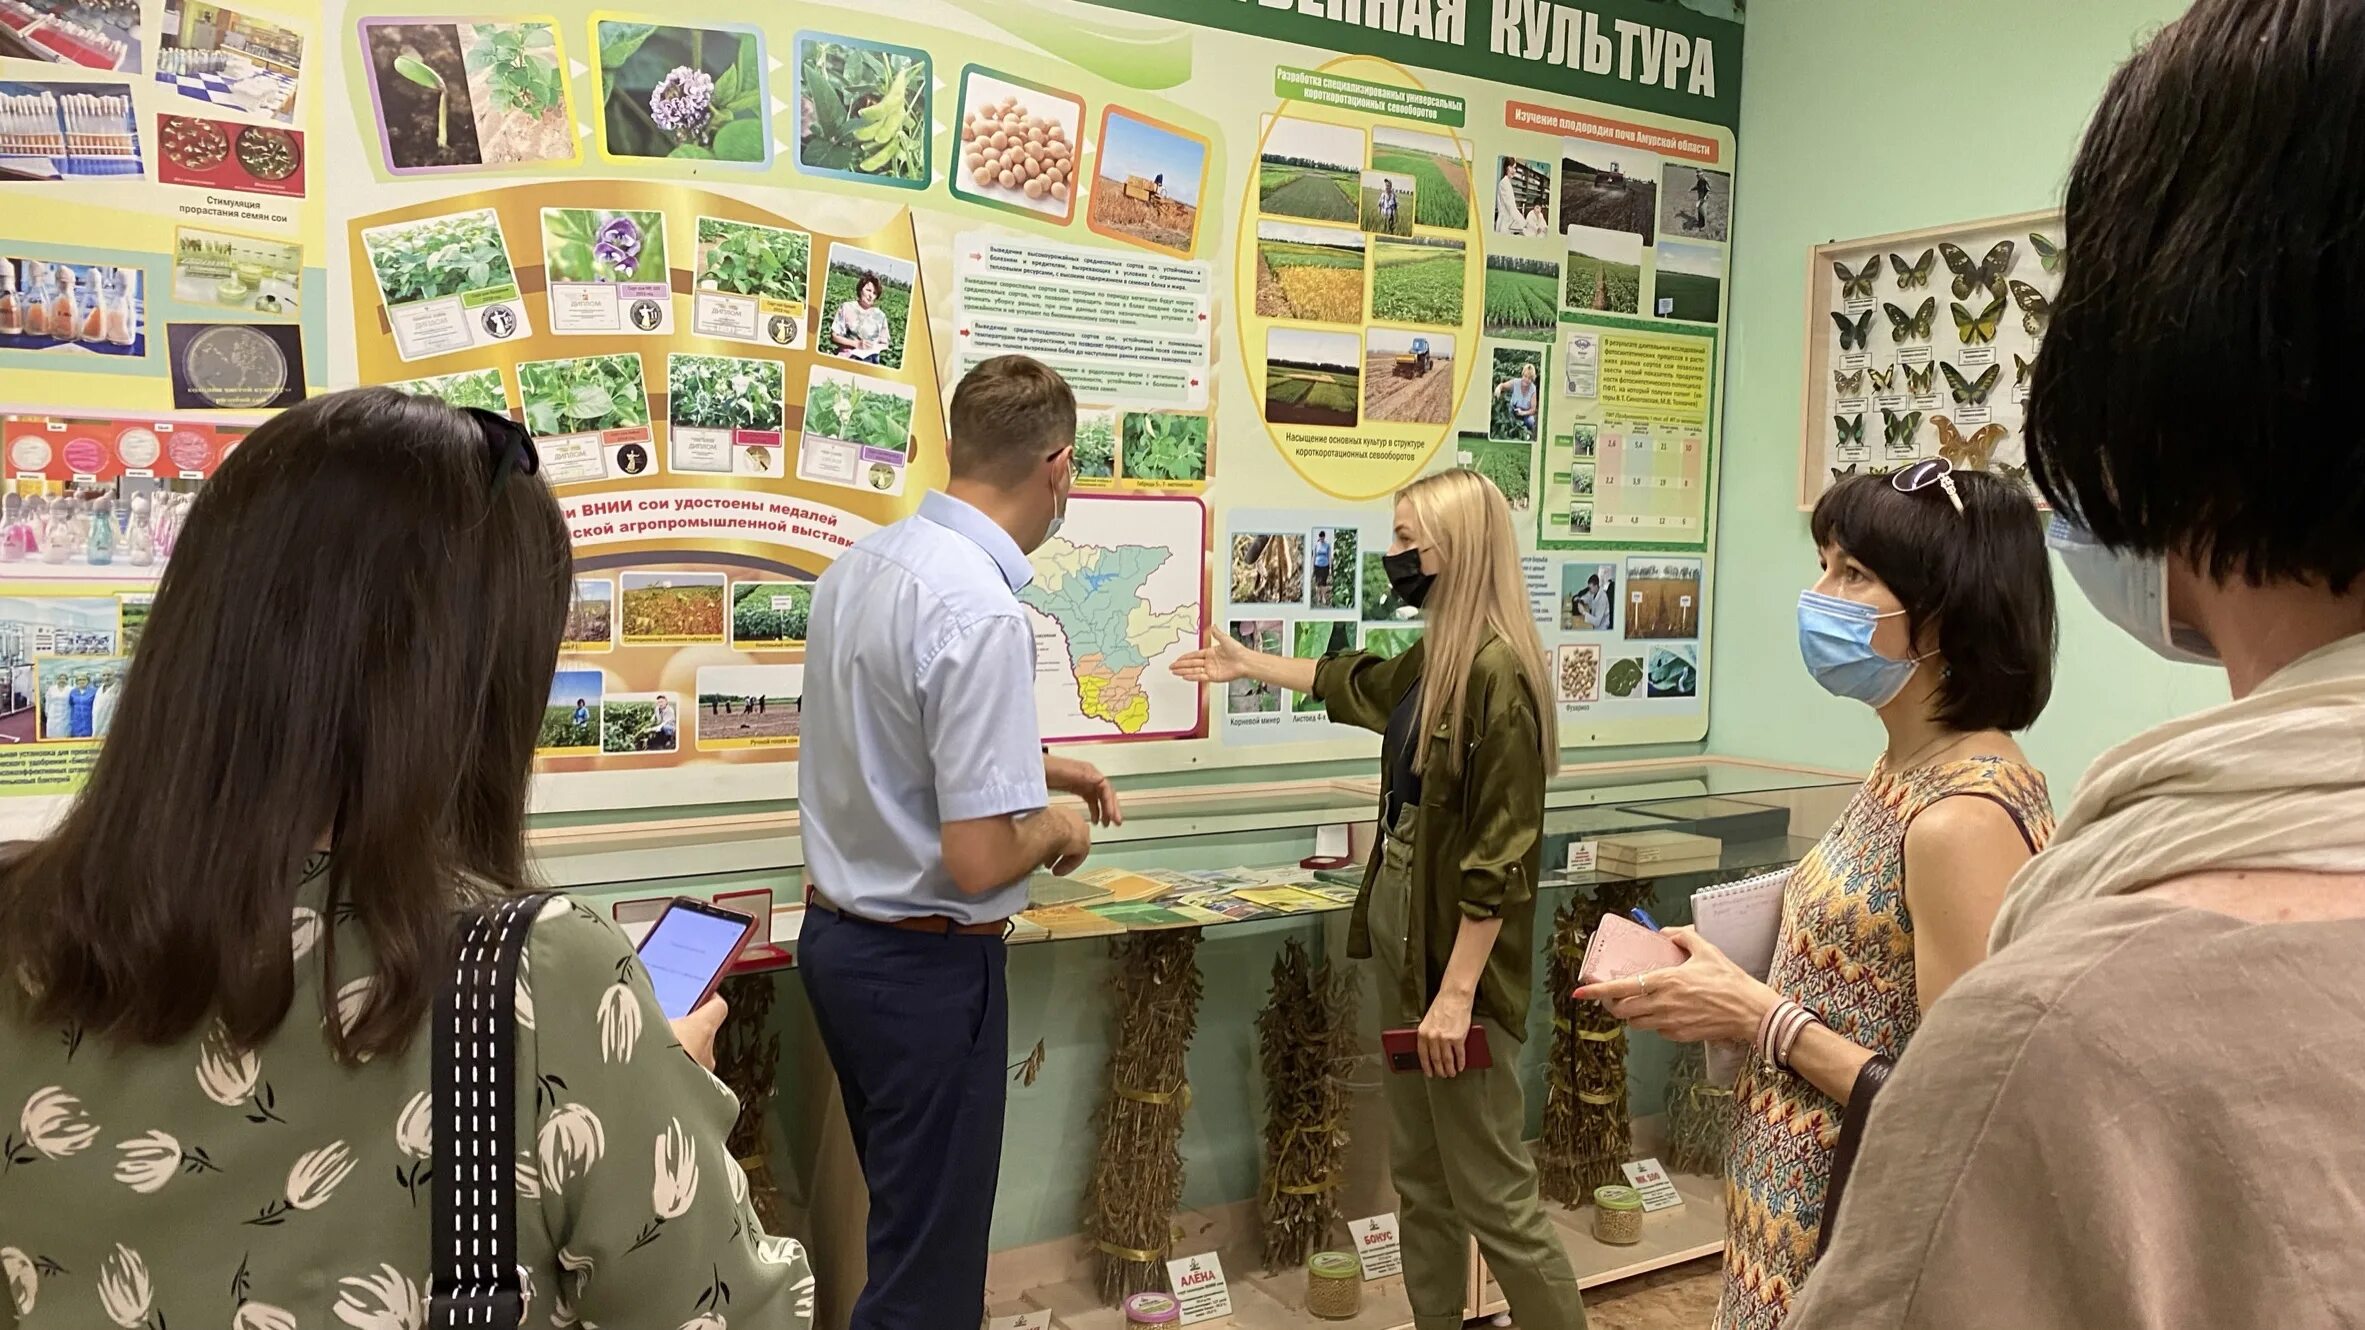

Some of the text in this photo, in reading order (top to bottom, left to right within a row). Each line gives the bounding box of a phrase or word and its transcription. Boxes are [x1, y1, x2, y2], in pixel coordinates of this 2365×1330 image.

[1490, 0, 1716, 98] КУЛЬТУРА
[1276, 68, 1463, 112] Разработка специализированных универсальных
[1304, 88, 1438, 120] короткоротационных севооборотов
[1515, 108, 1710, 155] Изучение плодородия почв Амурской области
[206, 196, 260, 210] Стимуляция
[179, 204, 288, 222] прорастания семян сои
[1286, 432, 1328, 444] Насыщение
[1328, 437, 1362, 446] основных
[1363, 438, 1387, 448] культур
[1394, 440, 1425, 449] структуре
[1296, 448, 1415, 462] короткоротационных севооборотов
[582, 498, 837, 527] ВНИИ сои удостоены медалей
[619, 518, 787, 533] агропромышленной
[1364, 1231, 1393, 1245] БОНУС
[1181, 1270, 1216, 1287] АЛЁНА
